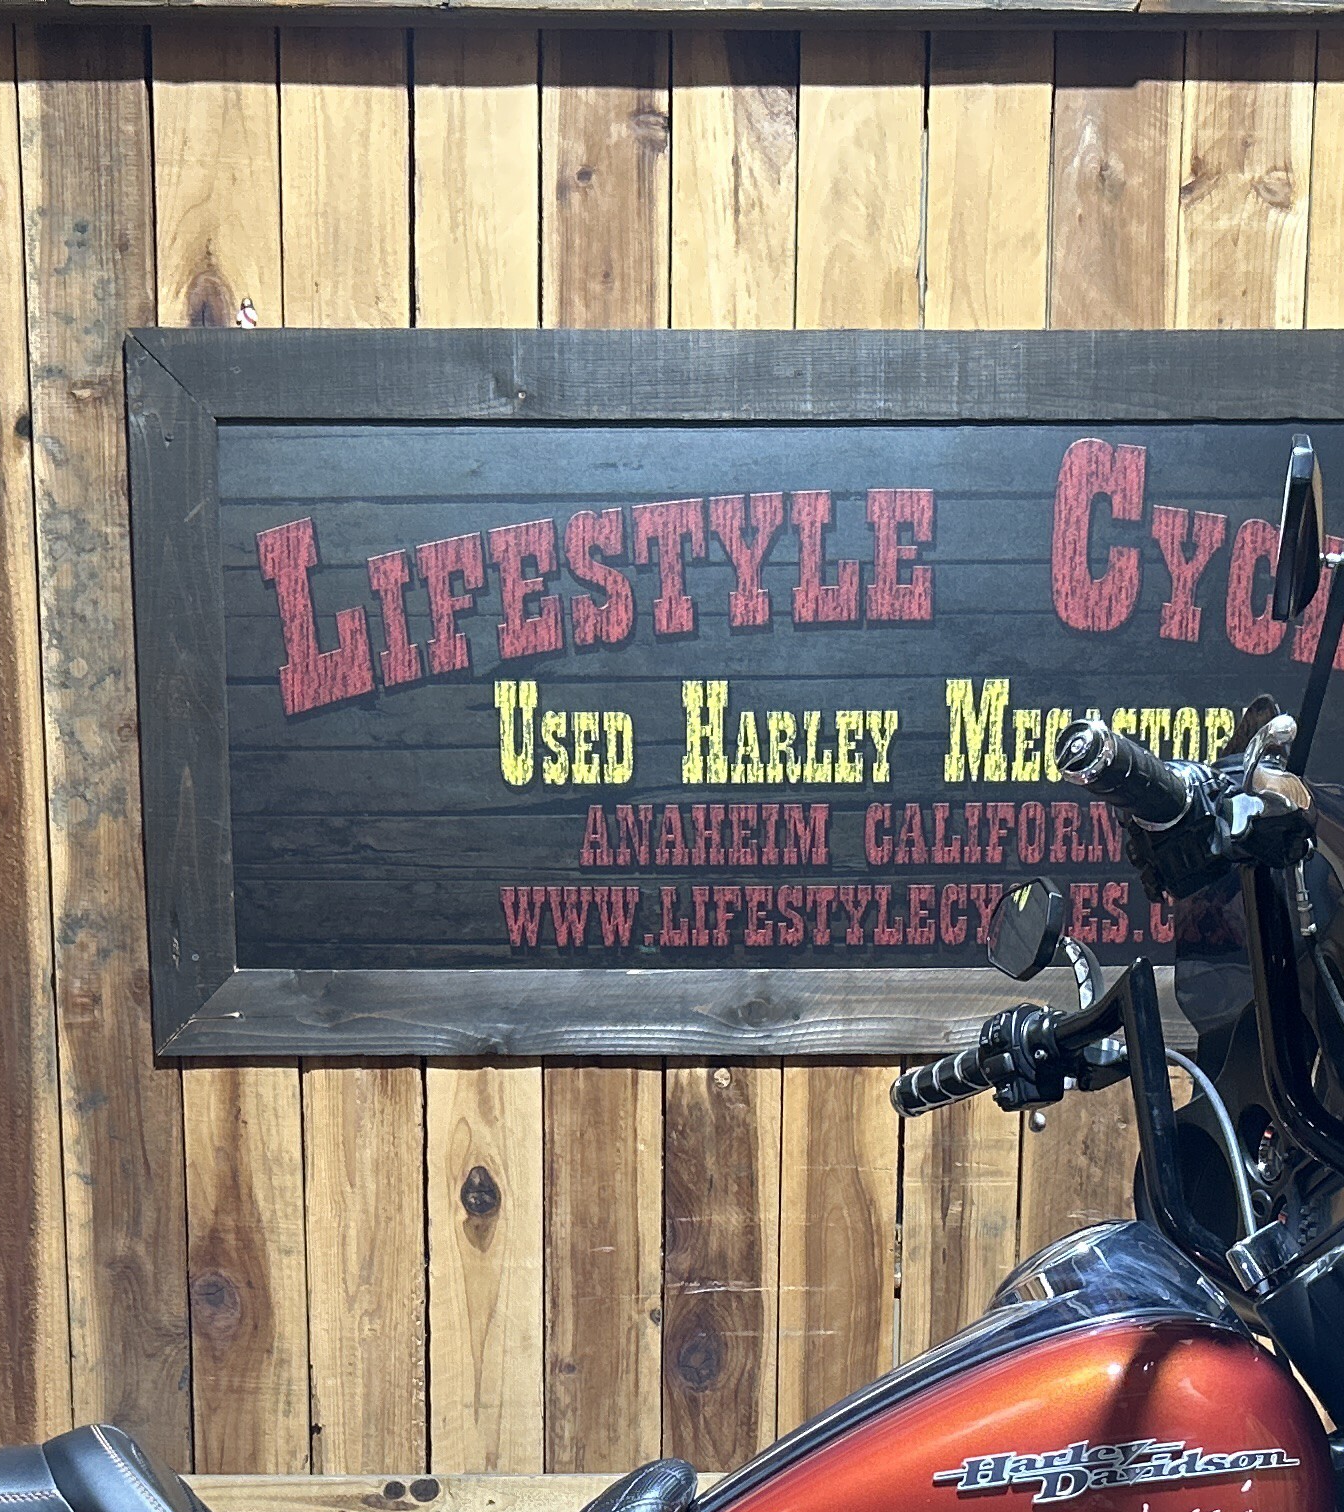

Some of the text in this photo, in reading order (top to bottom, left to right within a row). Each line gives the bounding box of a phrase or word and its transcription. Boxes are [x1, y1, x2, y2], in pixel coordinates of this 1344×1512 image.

[256, 488, 934, 716] LIFESTYLE
[494, 680, 632, 786] USED
[681, 680, 898, 783] HARLEY
[580, 804, 830, 866] ANAHEIM
[1032, 1448, 1296, 1507] Davidson
